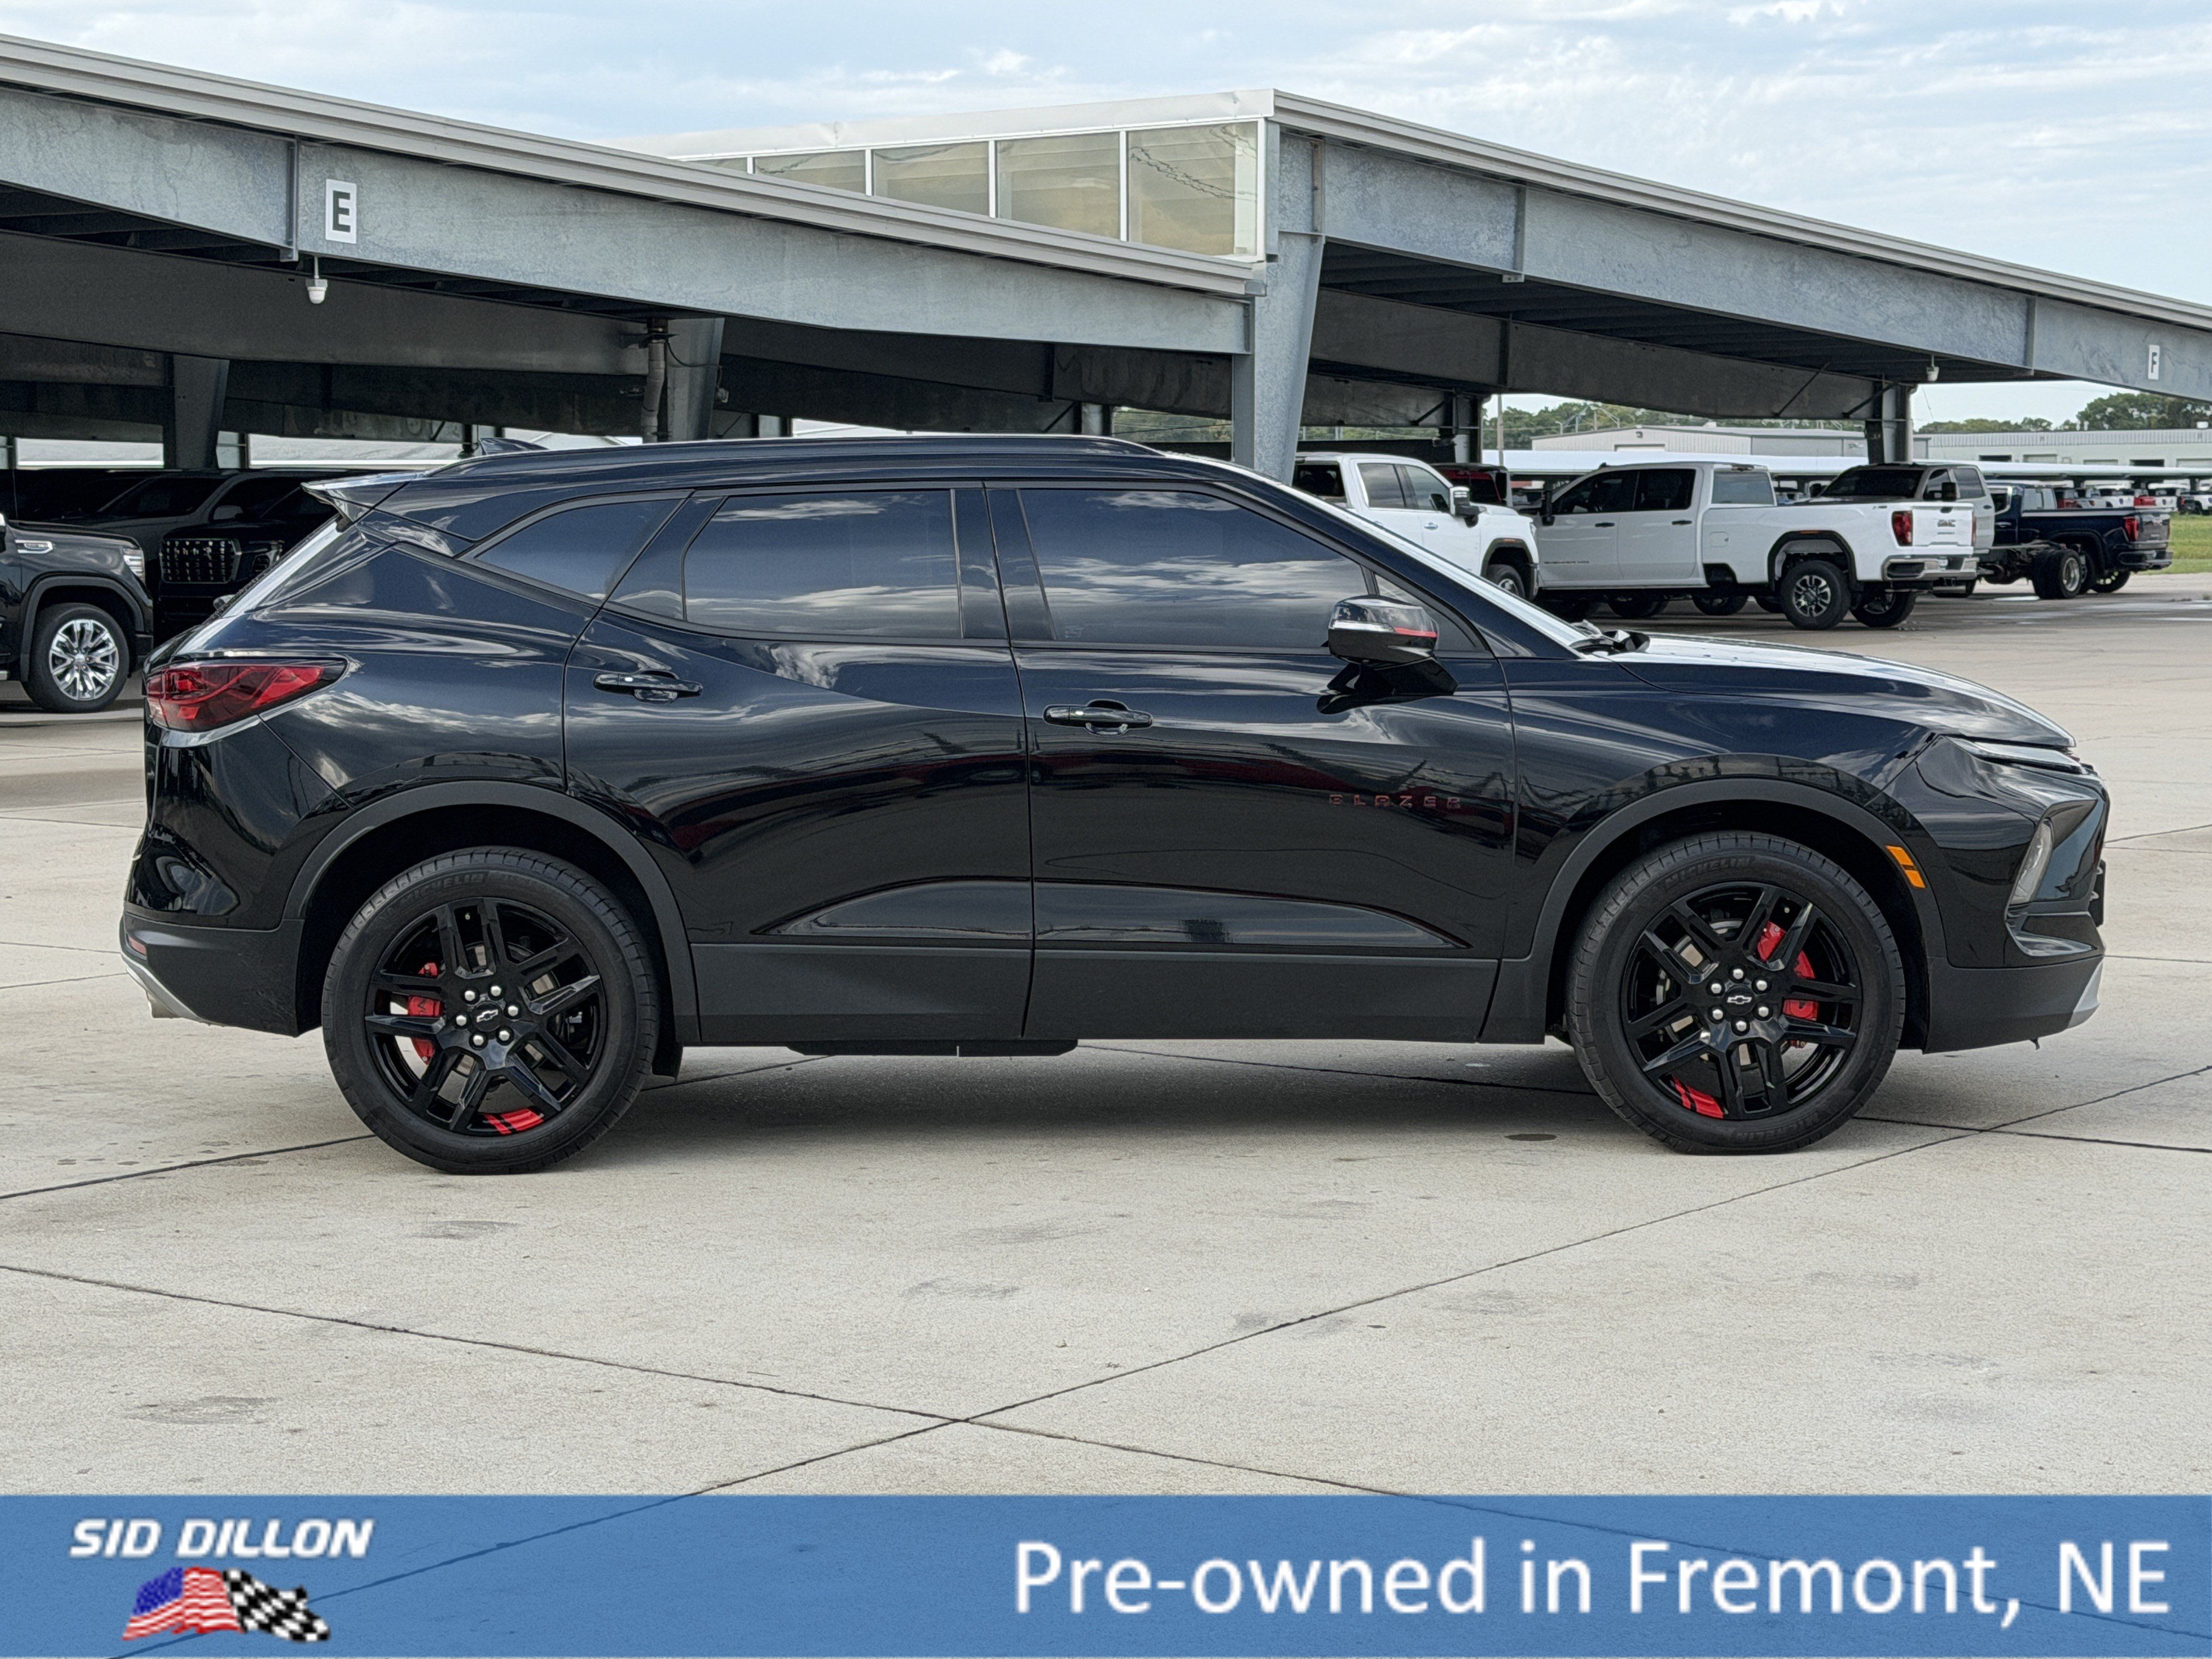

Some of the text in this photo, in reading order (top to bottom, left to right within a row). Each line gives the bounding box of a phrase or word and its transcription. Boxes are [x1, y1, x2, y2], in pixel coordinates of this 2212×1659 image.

[332, 190, 351, 233] E
[2151, 352, 2157, 374] F
[1330, 794, 1461, 809] BLAZER
